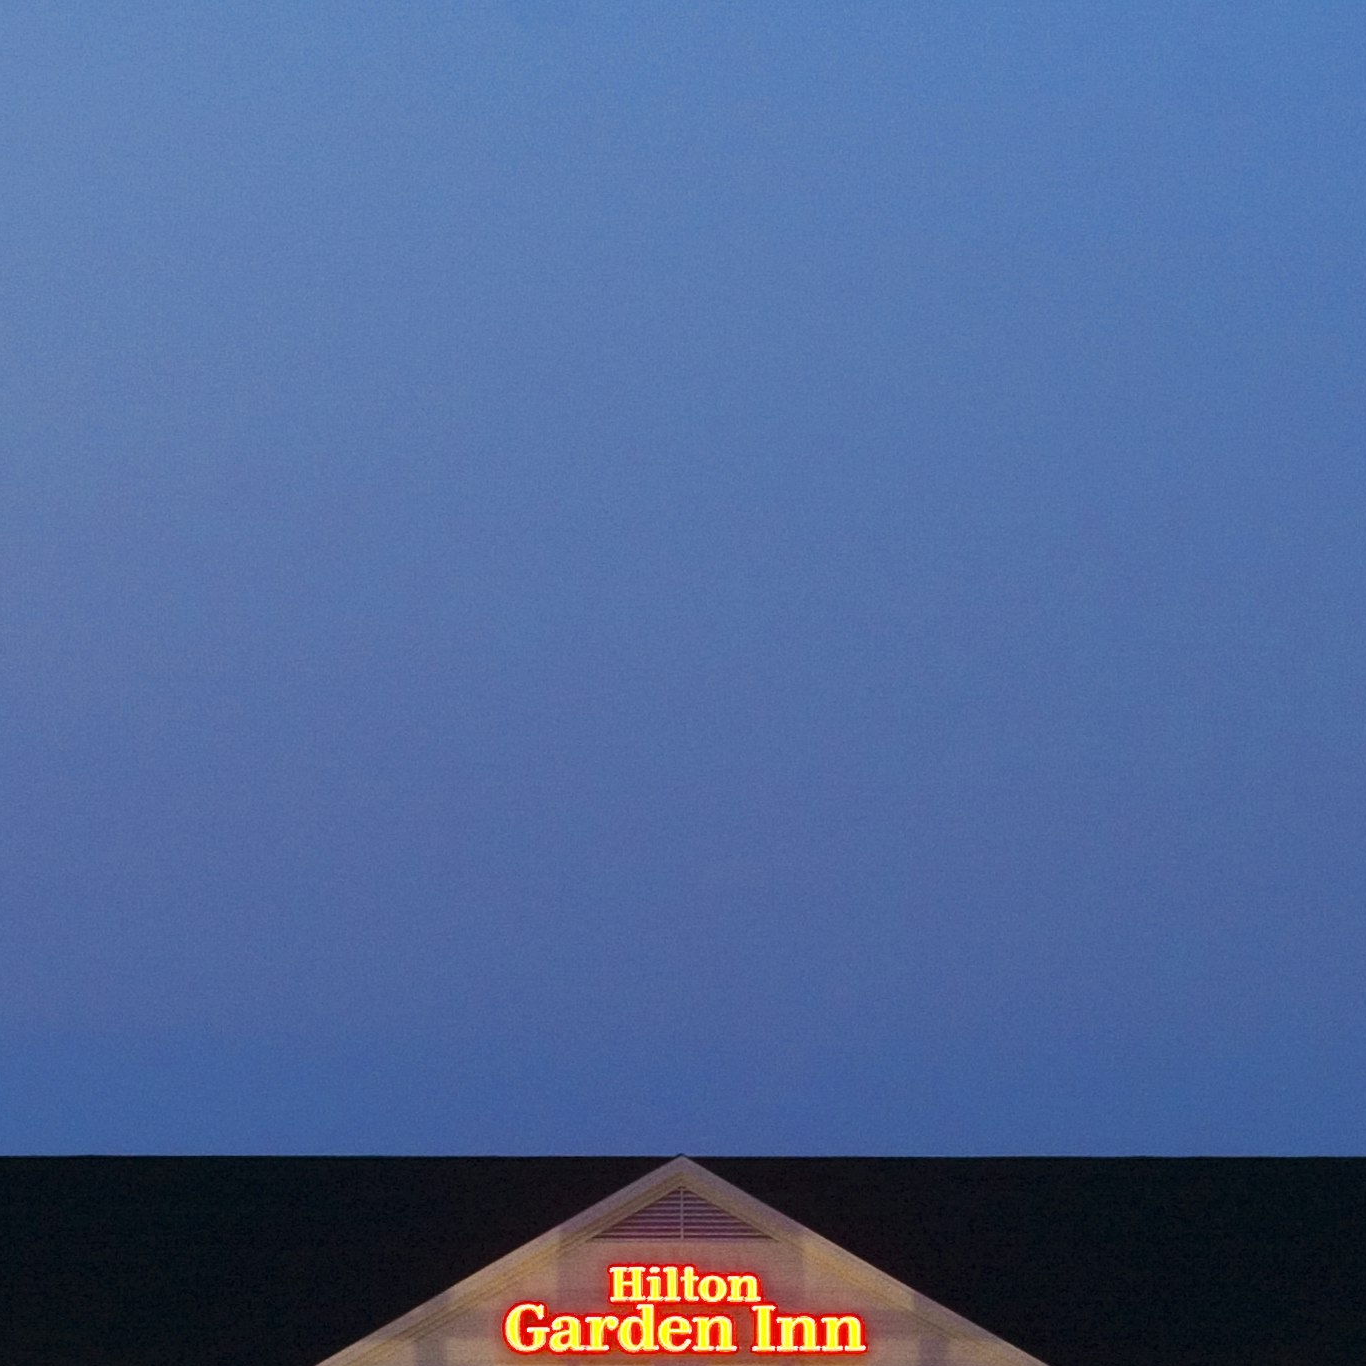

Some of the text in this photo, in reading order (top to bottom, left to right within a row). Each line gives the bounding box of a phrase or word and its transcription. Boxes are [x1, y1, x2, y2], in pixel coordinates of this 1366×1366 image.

[608, 1264, 762, 1303] Hilton
[503, 1303, 868, 1353] Garden Inn
